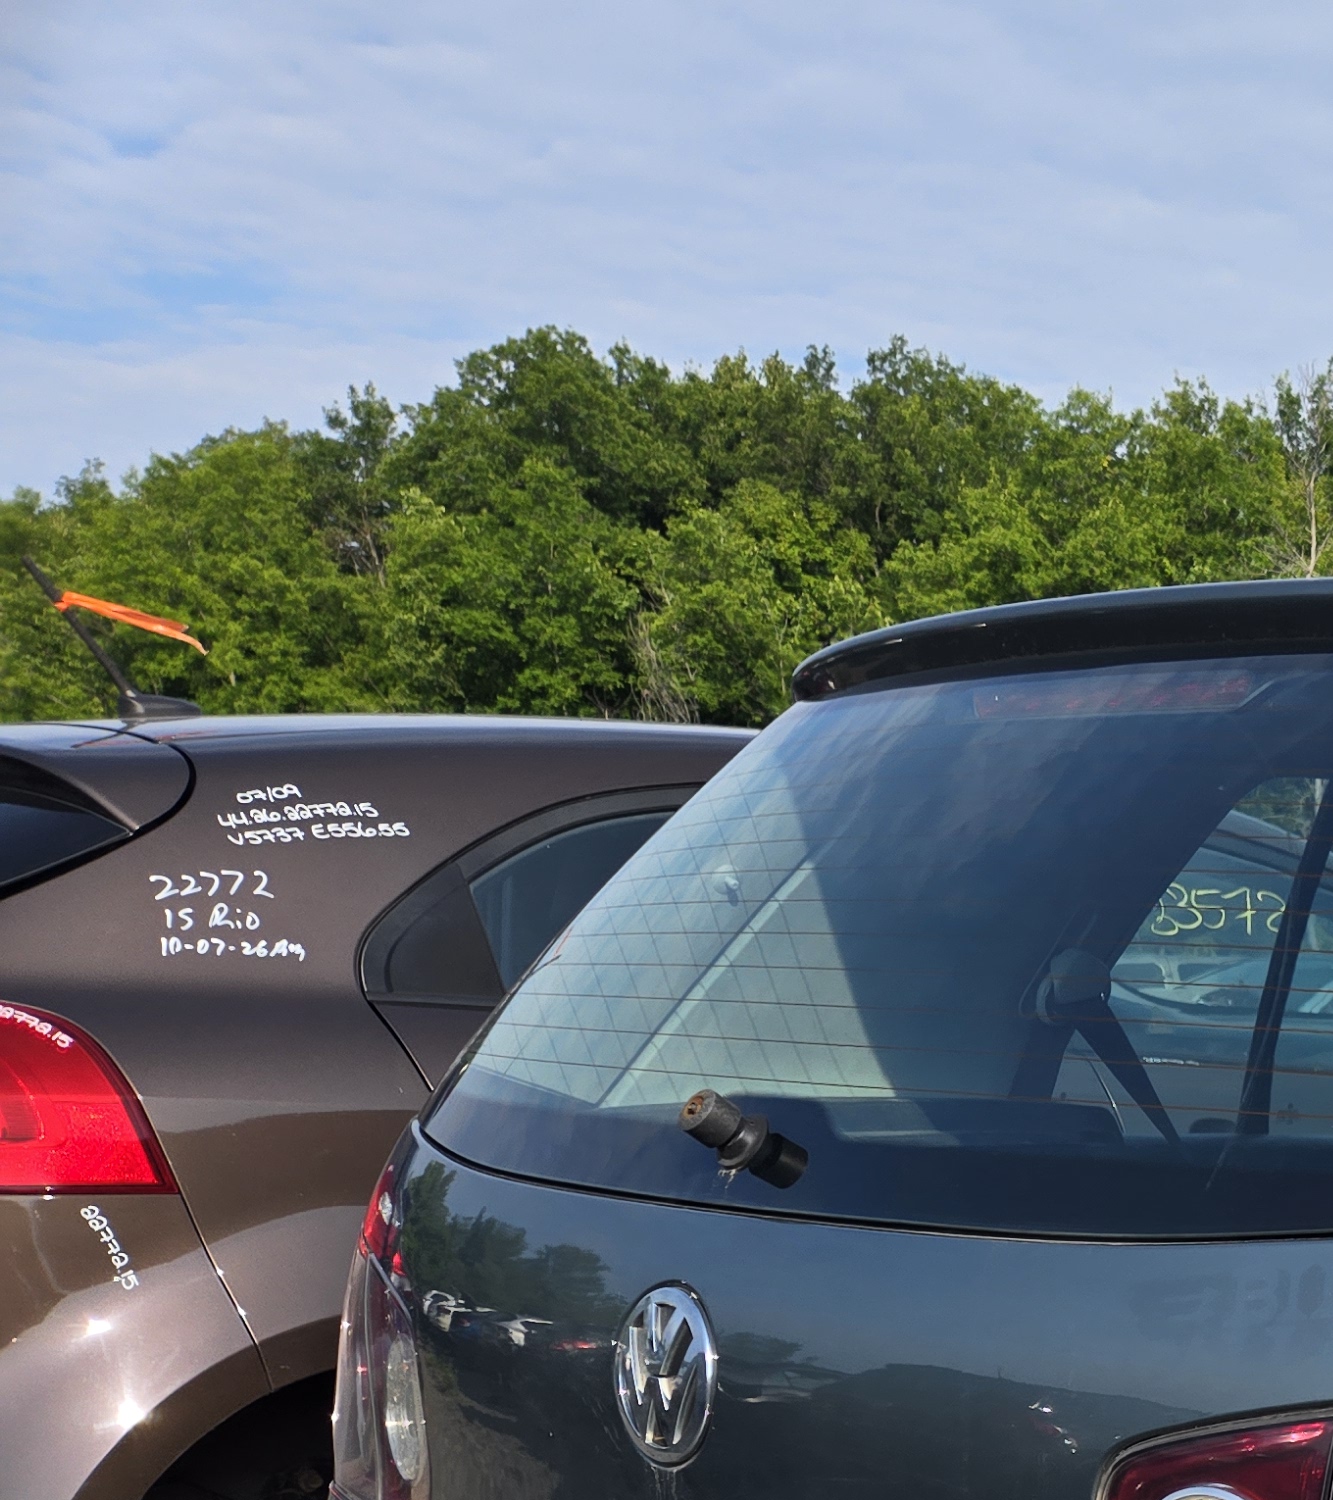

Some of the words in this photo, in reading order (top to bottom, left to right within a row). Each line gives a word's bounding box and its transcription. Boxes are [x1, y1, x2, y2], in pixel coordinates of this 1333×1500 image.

[236, 783, 303, 804] 07/09
[227, 828, 305, 846] V5737
[149, 869, 275, 901] 22772
[164, 907, 194, 931] 15
[0, 1004, 75, 1049] 2772.15
